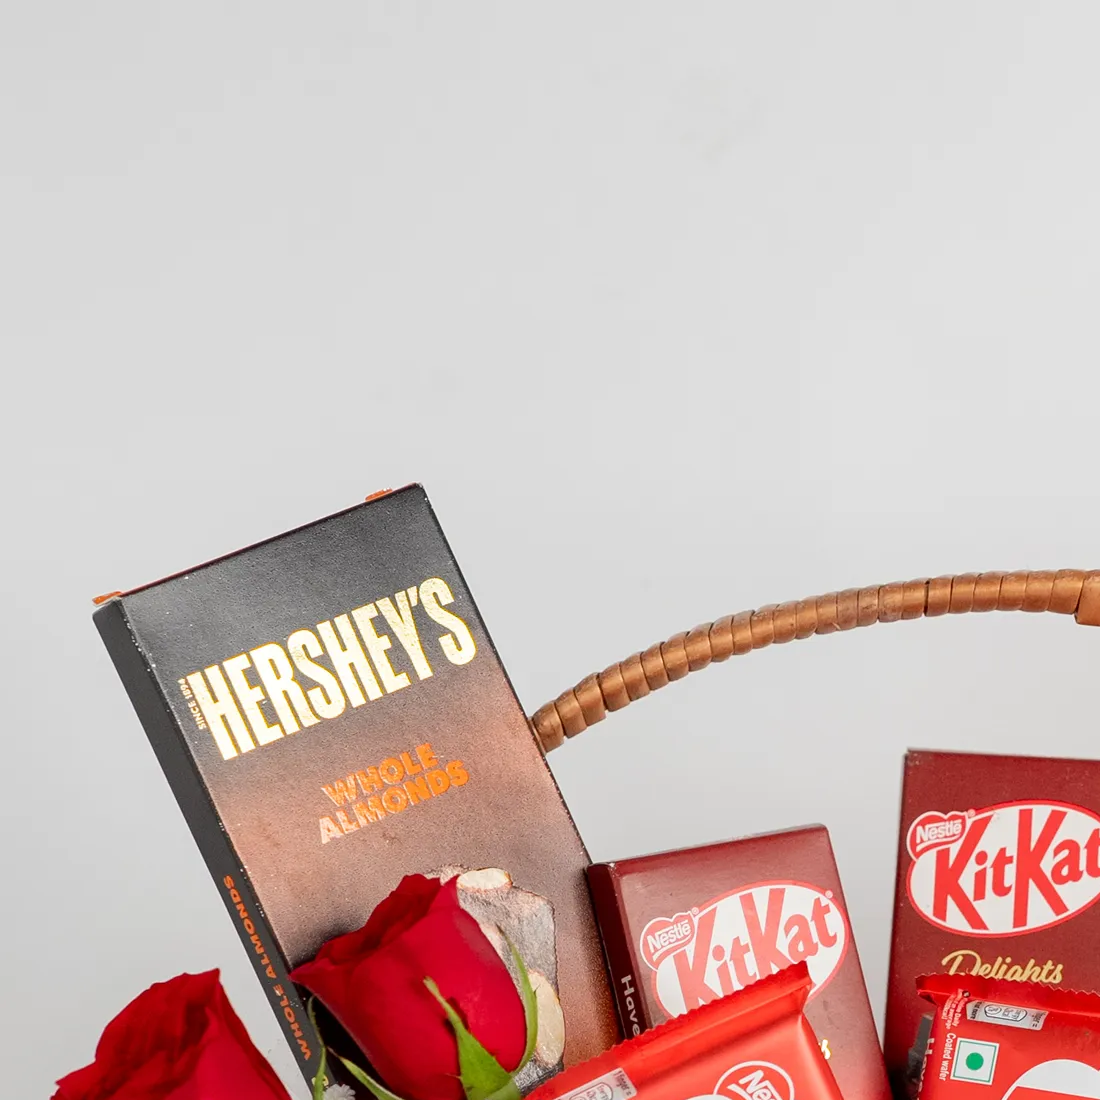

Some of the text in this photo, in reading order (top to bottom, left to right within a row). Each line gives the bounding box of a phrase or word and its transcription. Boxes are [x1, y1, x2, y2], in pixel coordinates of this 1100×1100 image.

[186, 577, 477, 760] HERSHEY'S
[177, 678, 207, 730] SINCE 1894
[319, 760, 470, 844] ALMONDS
[321, 743, 440, 806] WHOLE
[223, 875, 313, 1061] WHOLE ALMONDS
[939, 1060, 950, 1081] wafer
[943, 1033, 957, 1060] Coated
